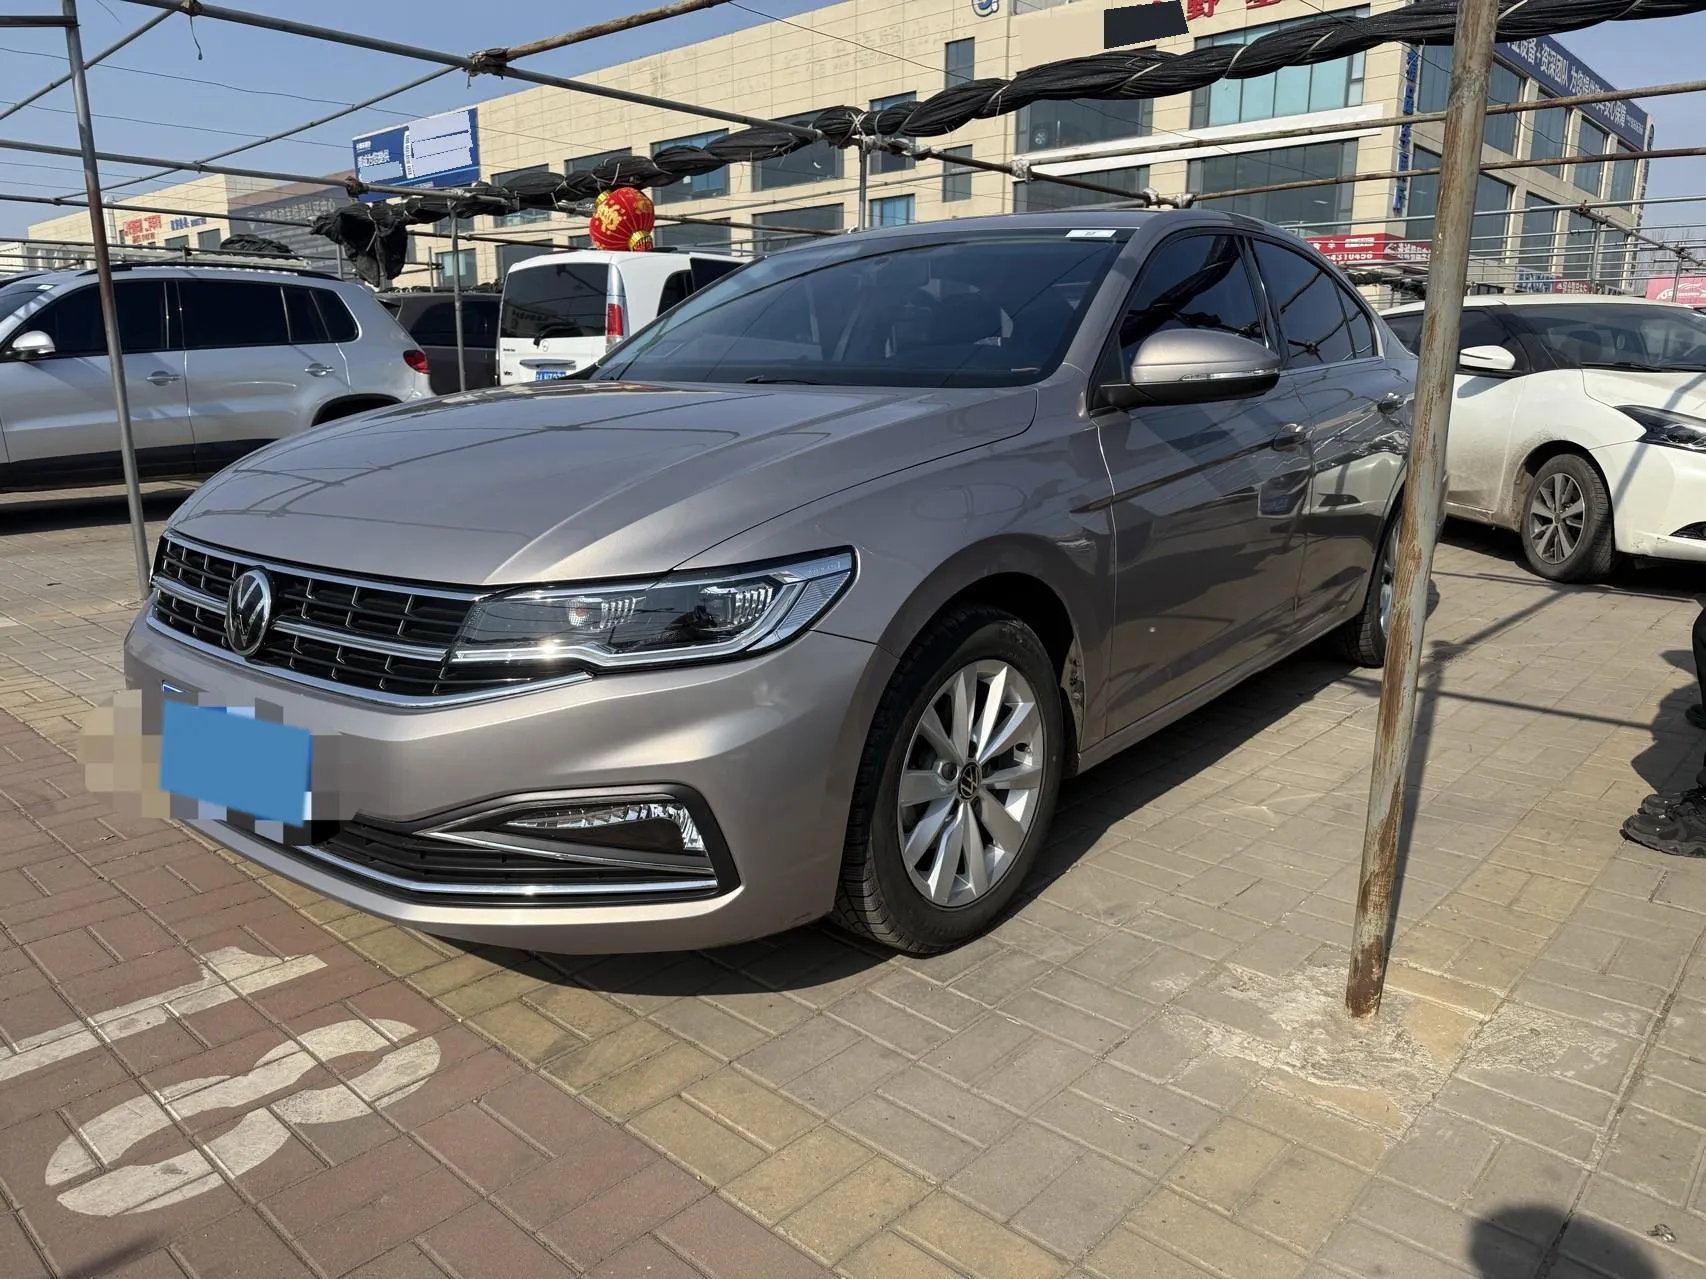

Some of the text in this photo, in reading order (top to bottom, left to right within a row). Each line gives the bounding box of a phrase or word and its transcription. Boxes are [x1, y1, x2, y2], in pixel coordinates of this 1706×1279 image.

[1506, 37, 1568, 87] 业设备+资深团队
